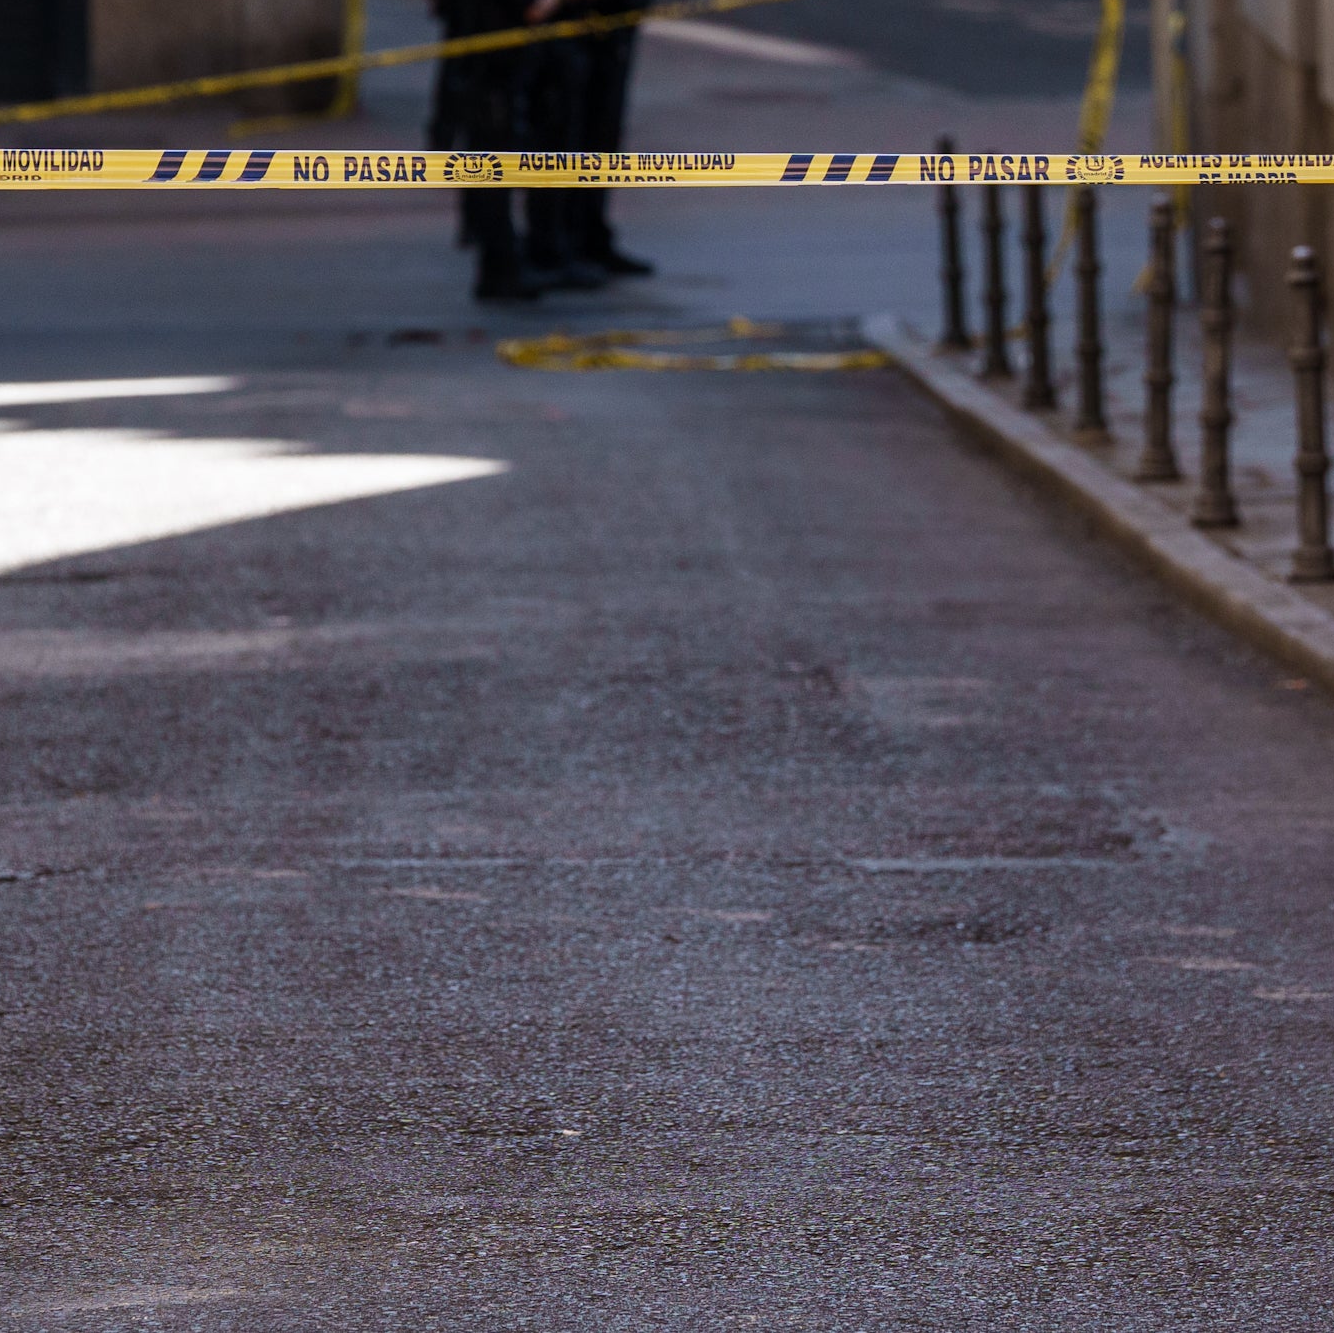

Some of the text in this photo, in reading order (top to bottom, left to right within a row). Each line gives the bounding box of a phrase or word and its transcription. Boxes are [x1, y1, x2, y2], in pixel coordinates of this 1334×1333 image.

[3, 149, 104, 172] MOVILIDAD
[293, 156, 427, 183] NO PASAR
[518, 154, 735, 171] AGENTES DE MOVILIDAD
[919, 156, 1050, 181] NO PASAR
